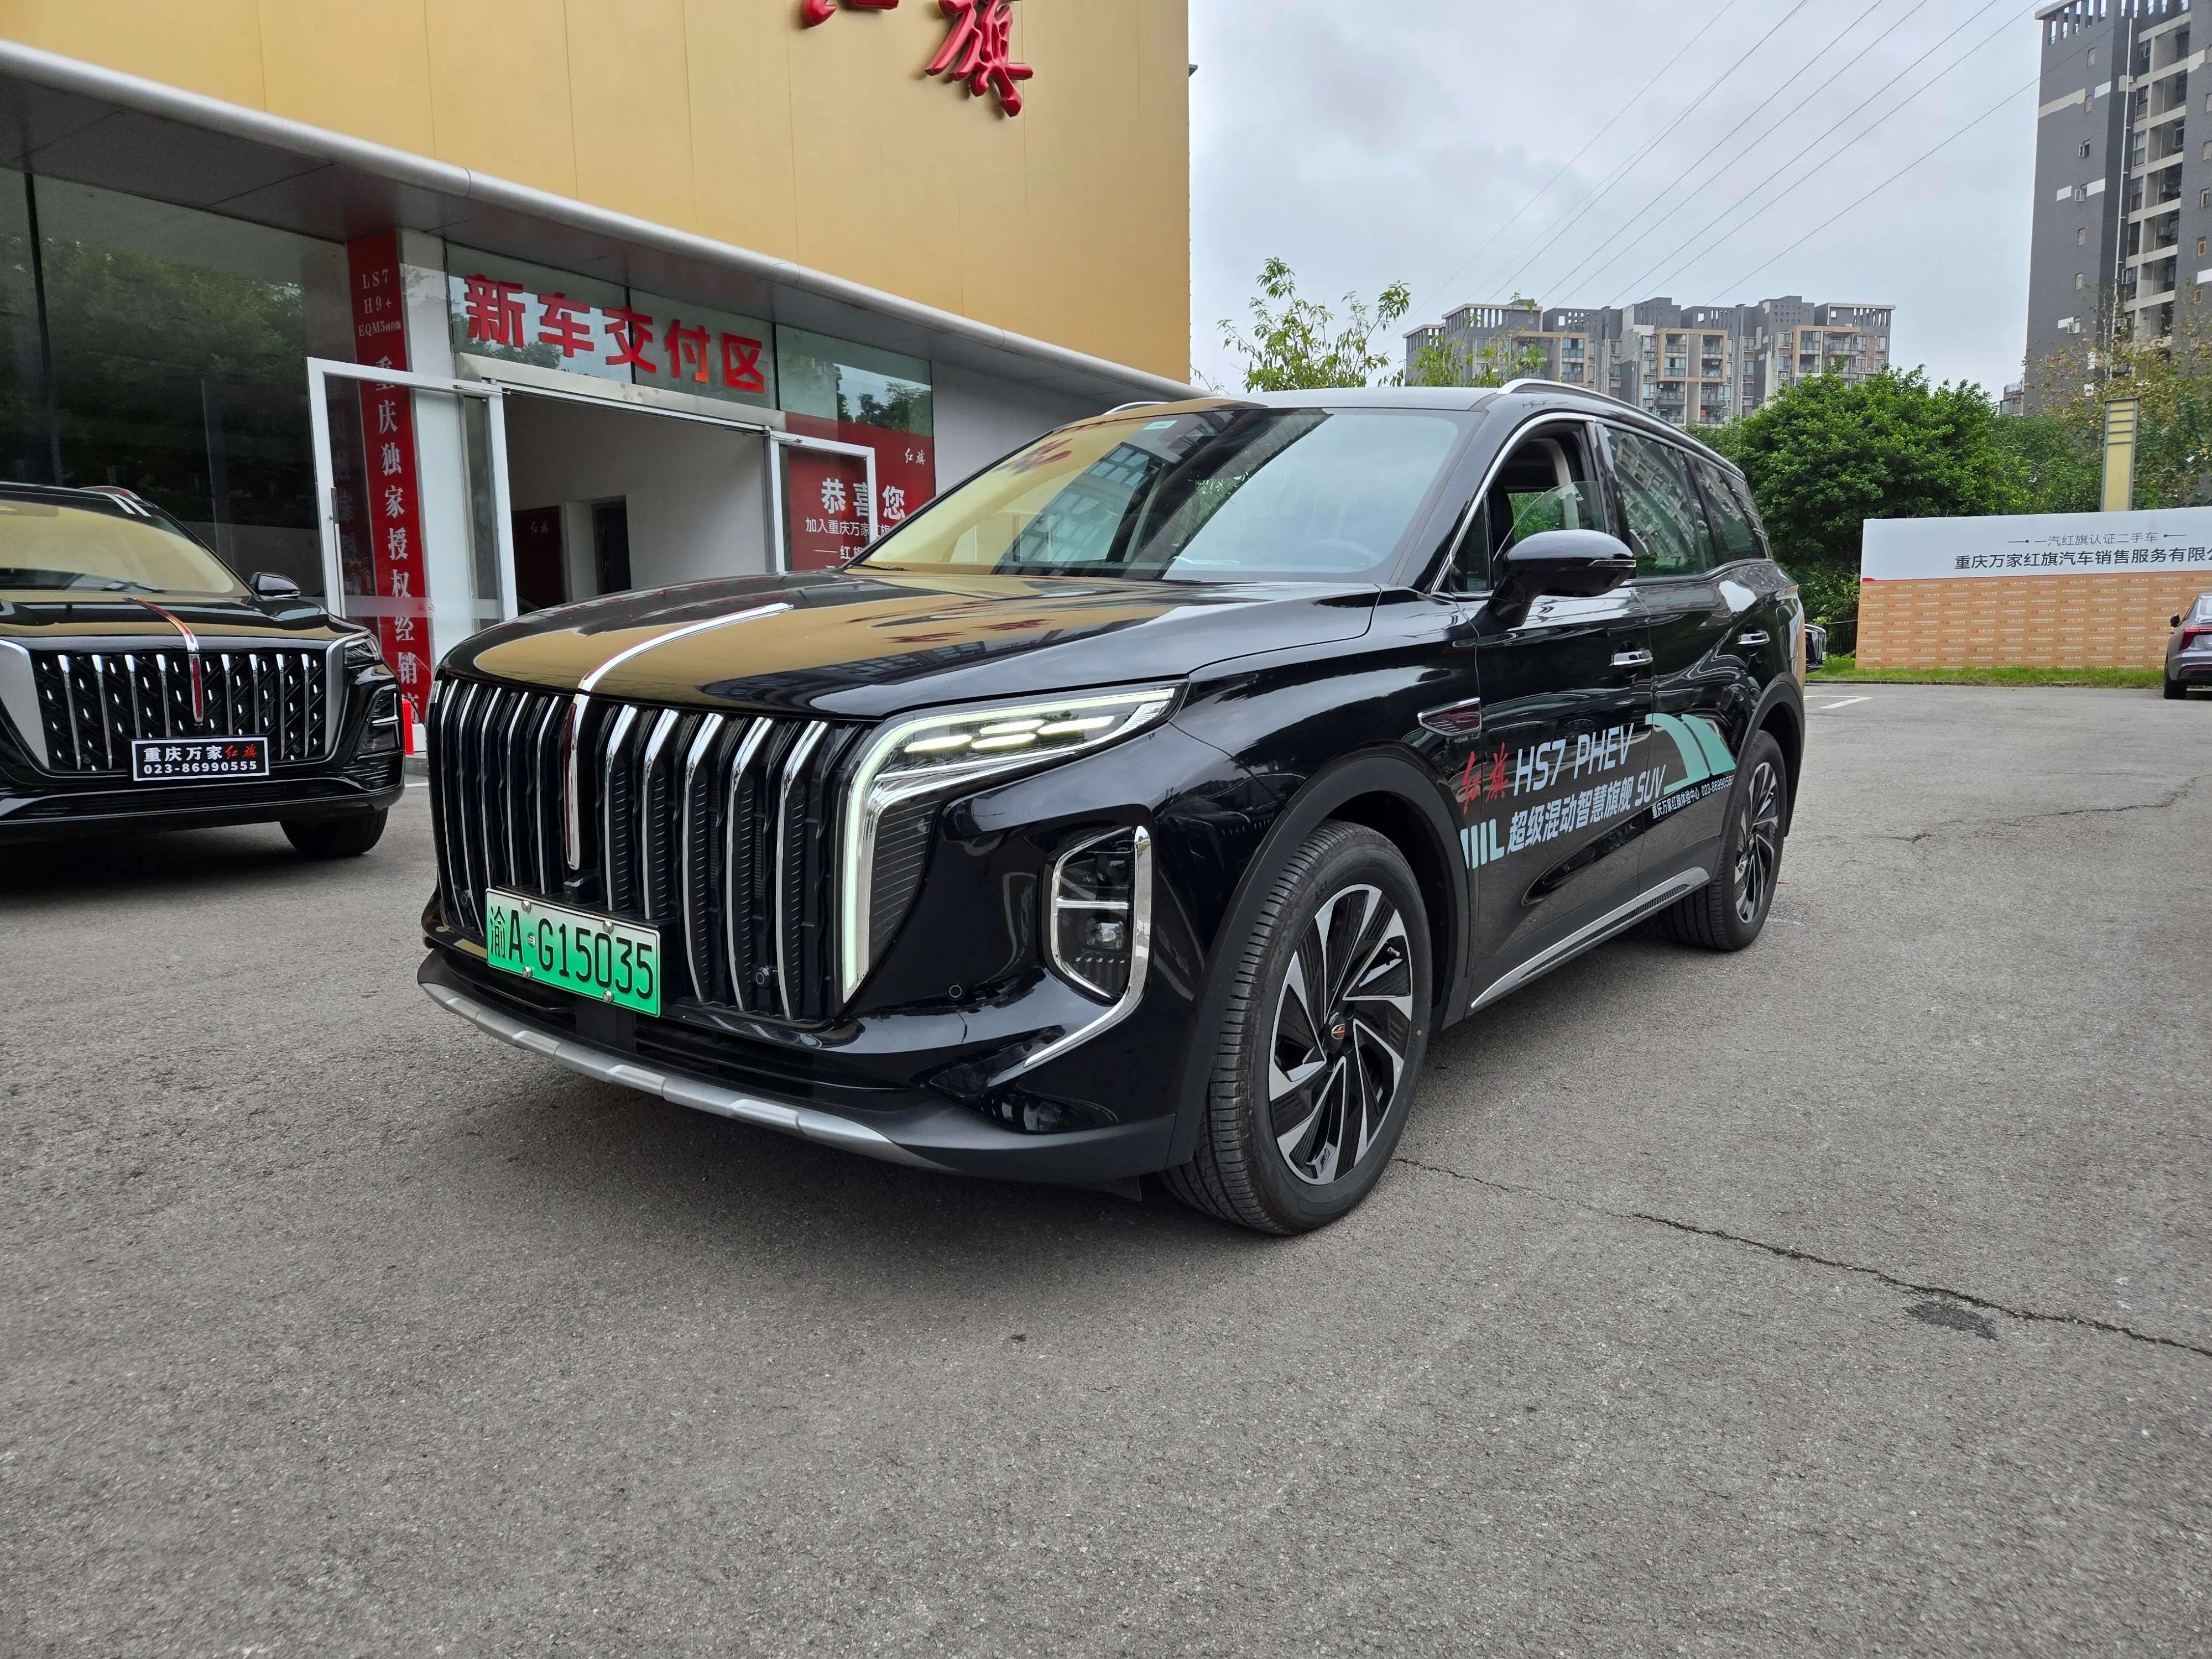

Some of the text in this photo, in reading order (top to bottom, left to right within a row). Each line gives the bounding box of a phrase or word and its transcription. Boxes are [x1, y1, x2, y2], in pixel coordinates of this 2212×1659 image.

[362, 269, 388, 289] LS7
[363, 296, 392, 314] H9+
[464, 274, 765, 393] 新车交付区
[821, 478, 905, 520] 恭喜您
[2034, 531, 2158, 546] 一汽红旗认证二手车
[144, 761, 257, 774] 023-86990555
[1514, 739, 1566, 796] HS7
[1574, 722, 1634, 779] PHEV
[1507, 764, 1666, 855] 超级混动智慧旗舰 SUV
